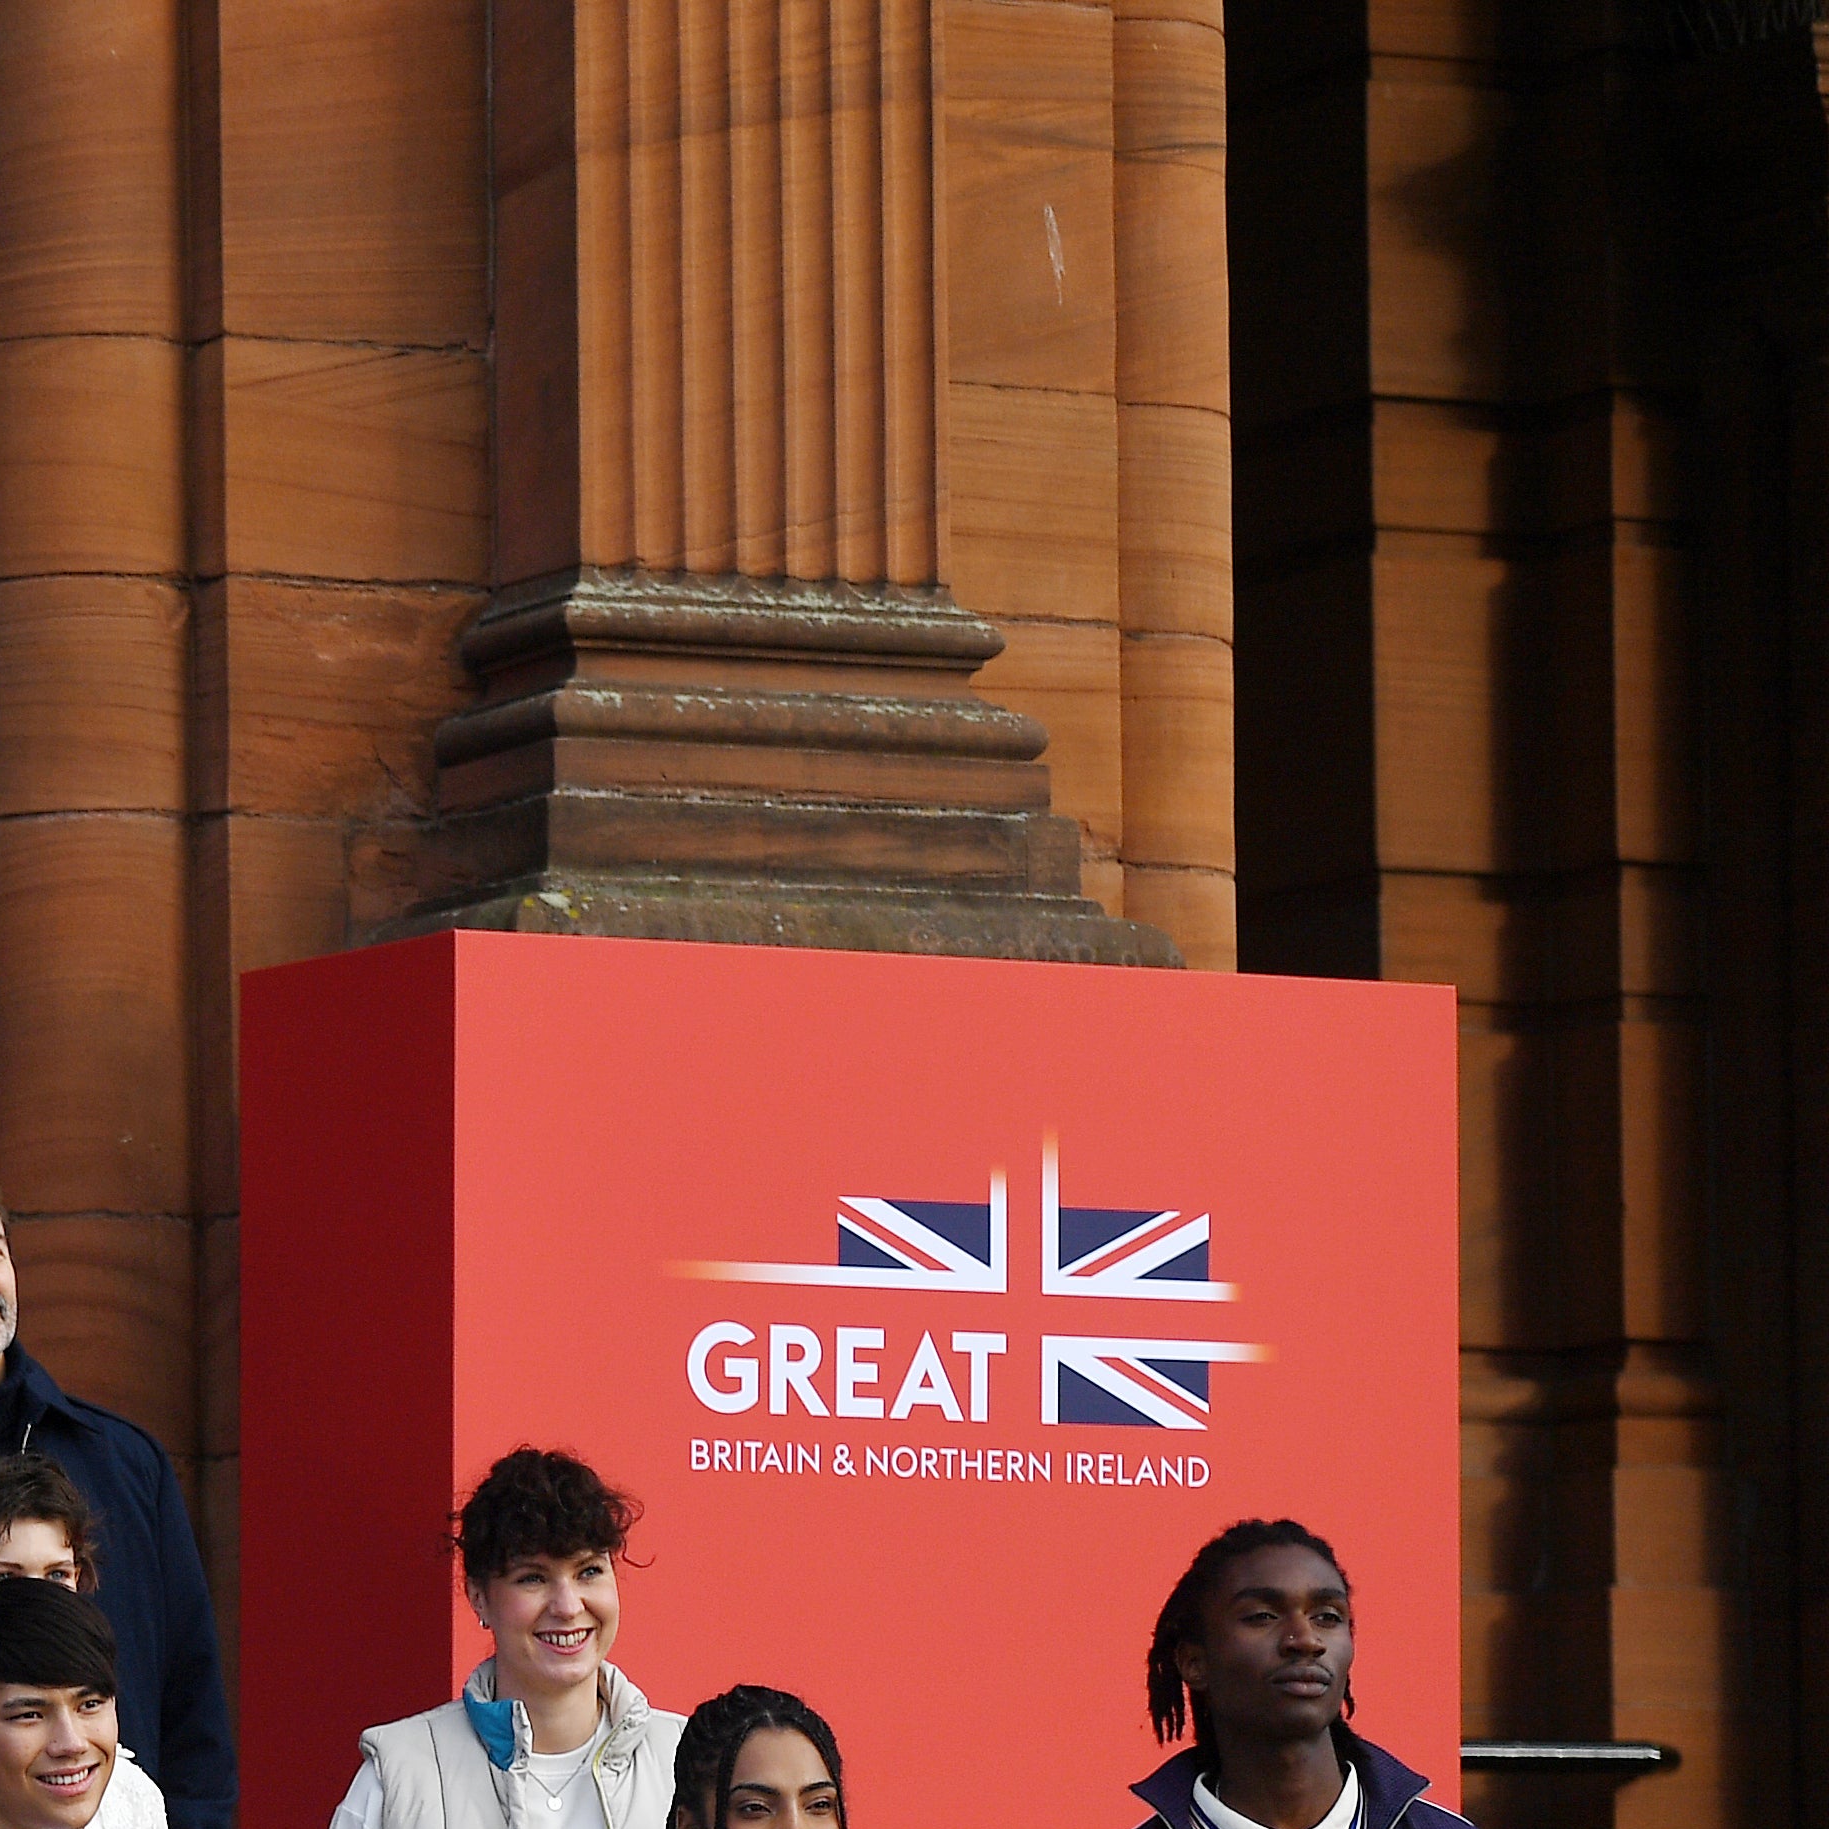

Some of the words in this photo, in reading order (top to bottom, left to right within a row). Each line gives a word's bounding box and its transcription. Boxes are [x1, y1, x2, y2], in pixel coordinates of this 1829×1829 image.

[686, 1320, 1008, 1423] GREAT
[689, 1438, 822, 1476] BRITAIN
[832, 1443, 857, 1477] &
[865, 1445, 1053, 1483] NORTHERN
[1065, 1452, 1211, 1489] IRELAND
